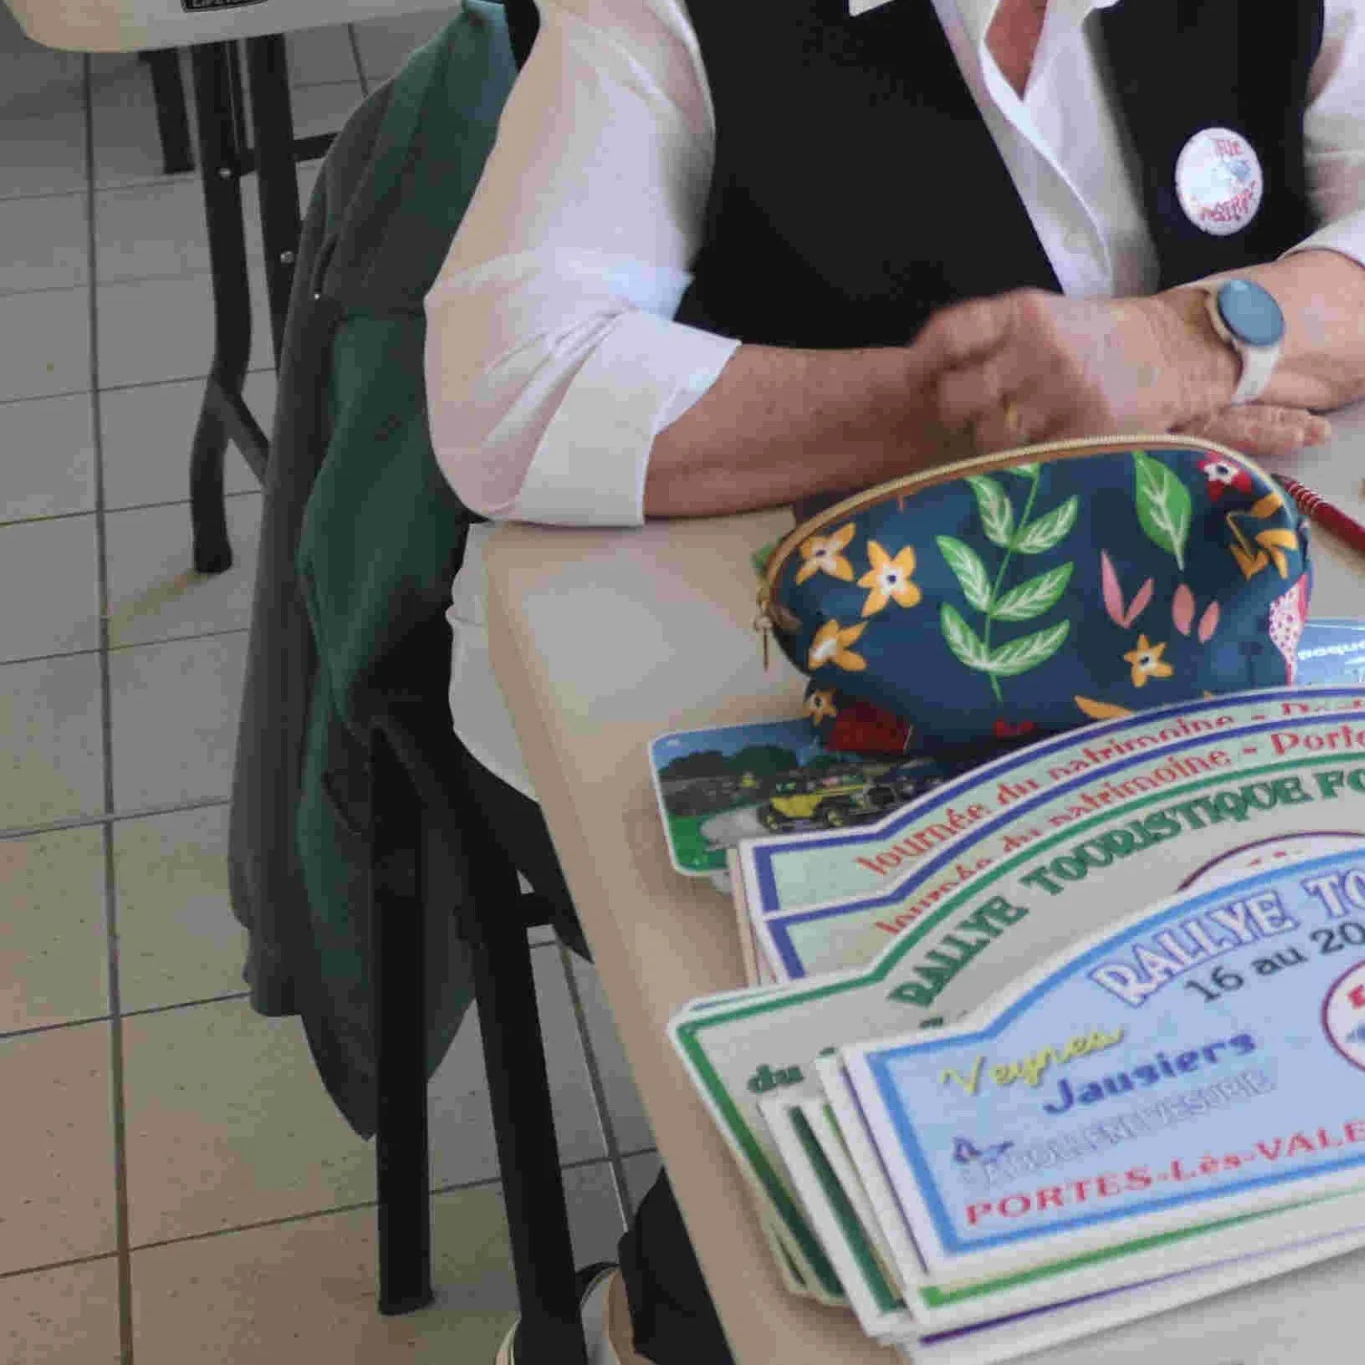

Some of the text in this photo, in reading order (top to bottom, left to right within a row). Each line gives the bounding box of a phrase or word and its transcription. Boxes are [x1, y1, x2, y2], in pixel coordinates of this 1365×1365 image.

[886, 895, 1030, 1007] RALLYE
[1018, 776, 1313, 897] TOURISTIQUE
[1090, 888, 1299, 1008] RALLYE
[1184, 967, 1245, 1004] 16
[1250, 945, 1303, 980] au
[1042, 1032, 1258, 1116] Jausiers
